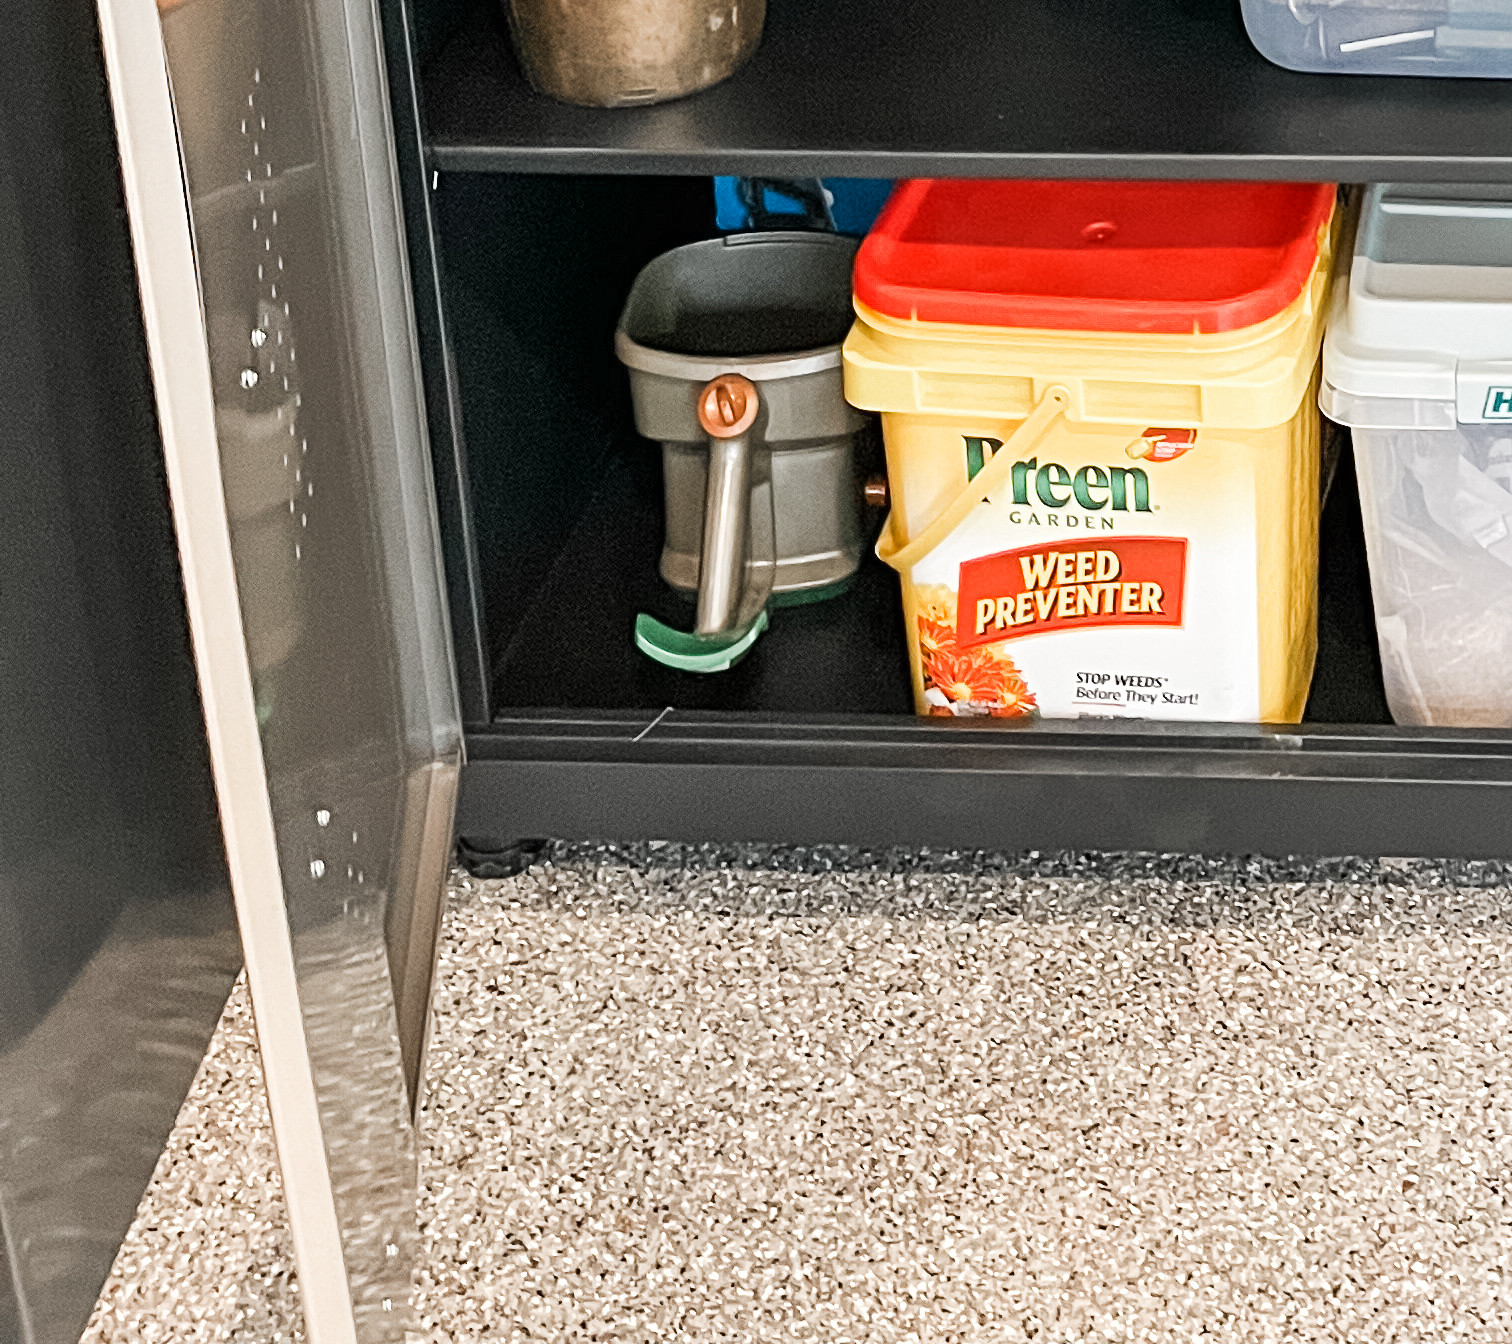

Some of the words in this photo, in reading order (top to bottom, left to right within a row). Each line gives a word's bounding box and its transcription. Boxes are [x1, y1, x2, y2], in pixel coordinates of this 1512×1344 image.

[1009, 511, 1114, 530] GARDEN
[1019, 550, 1122, 591] WEED
[975, 582, 1166, 635] PREVENTER
[1076, 672, 1111, 685] STOP
[1076, 686, 1122, 701] Before
[1125, 689, 1158, 705] They
[1161, 692, 1199, 705] Start!
